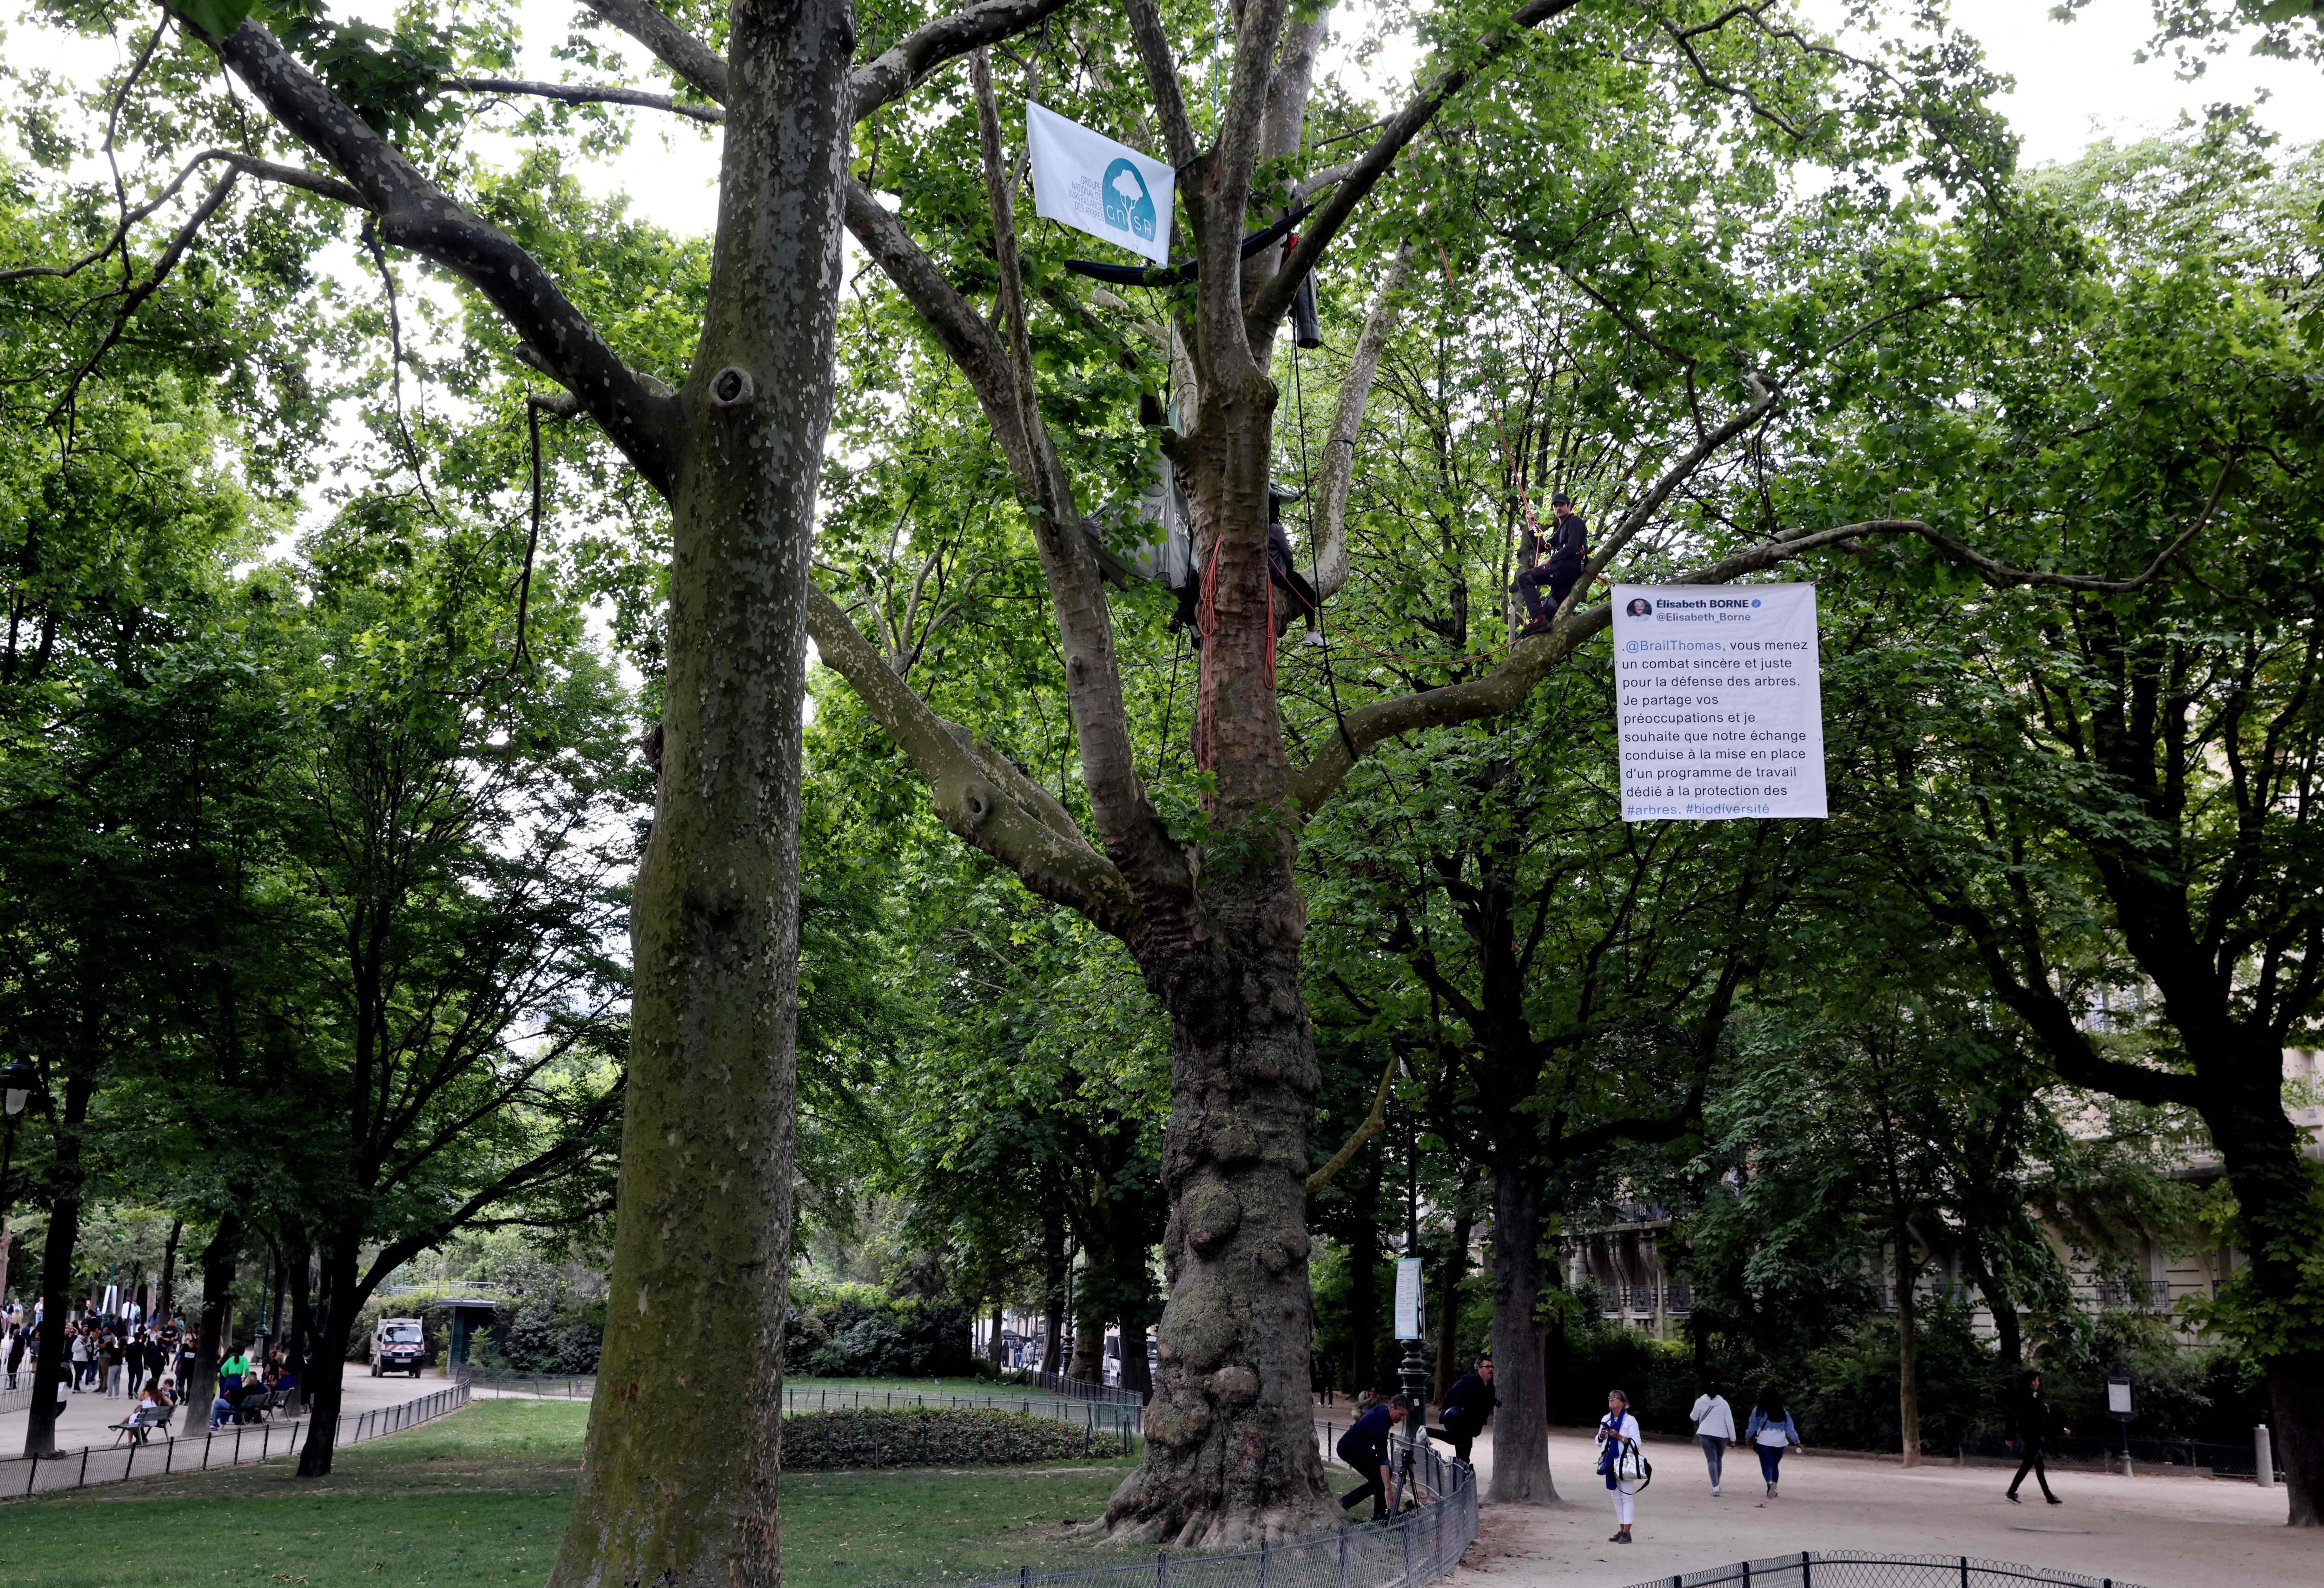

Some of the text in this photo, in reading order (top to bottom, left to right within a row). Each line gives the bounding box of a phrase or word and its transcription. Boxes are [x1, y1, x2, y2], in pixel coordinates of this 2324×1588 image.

[1081, 176, 1101, 192] GROUPE
[1071, 180, 1102, 203] NATIONAL DE
[1068, 189, 1103, 212] SURVEILLANCE
[1075, 201, 1104, 222] DES ARBRES
[1656, 598, 1750, 608] Élisabeth BORNE
[1656, 612, 1751, 623] @Elisabeth_Borne
[1622, 639, 1808, 654] .@BrailThomas, vous menez
[1622, 658, 1792, 671] un combat sincère et juste
[1623, 675, 1800, 690] pour la défense des arbres.
[1623, 695, 1718, 708] Je partage vos
[1624, 712, 1756, 726] préoccupations et je
[1624, 730, 1806, 744] souhaite que notre échange
[1625, 748, 1806, 762] conduise à la mise en place
[1625, 766, 1796, 781] d'un programme de travail
[1626, 784, 1788, 798] dédié à la protection des
[1627, 802, 1770, 816] #arbres. #biodiversité
